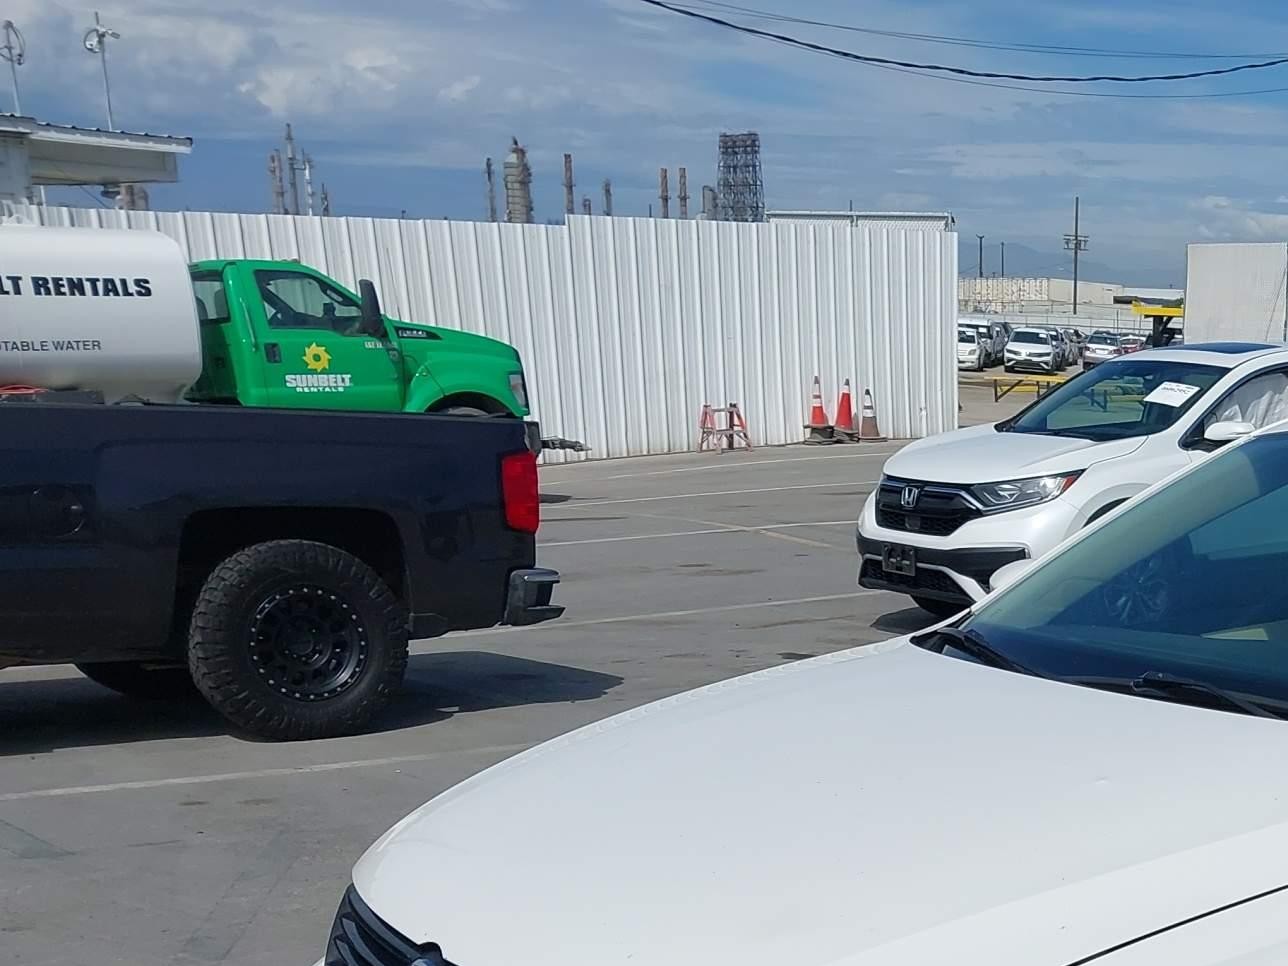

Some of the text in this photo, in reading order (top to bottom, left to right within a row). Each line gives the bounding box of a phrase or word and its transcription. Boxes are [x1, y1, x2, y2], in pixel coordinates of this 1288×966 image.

[31, 276, 152, 297] RENTALS
[0, 340, 102, 351] TABLE WATER
[285, 374, 352, 387] SUNBELT
